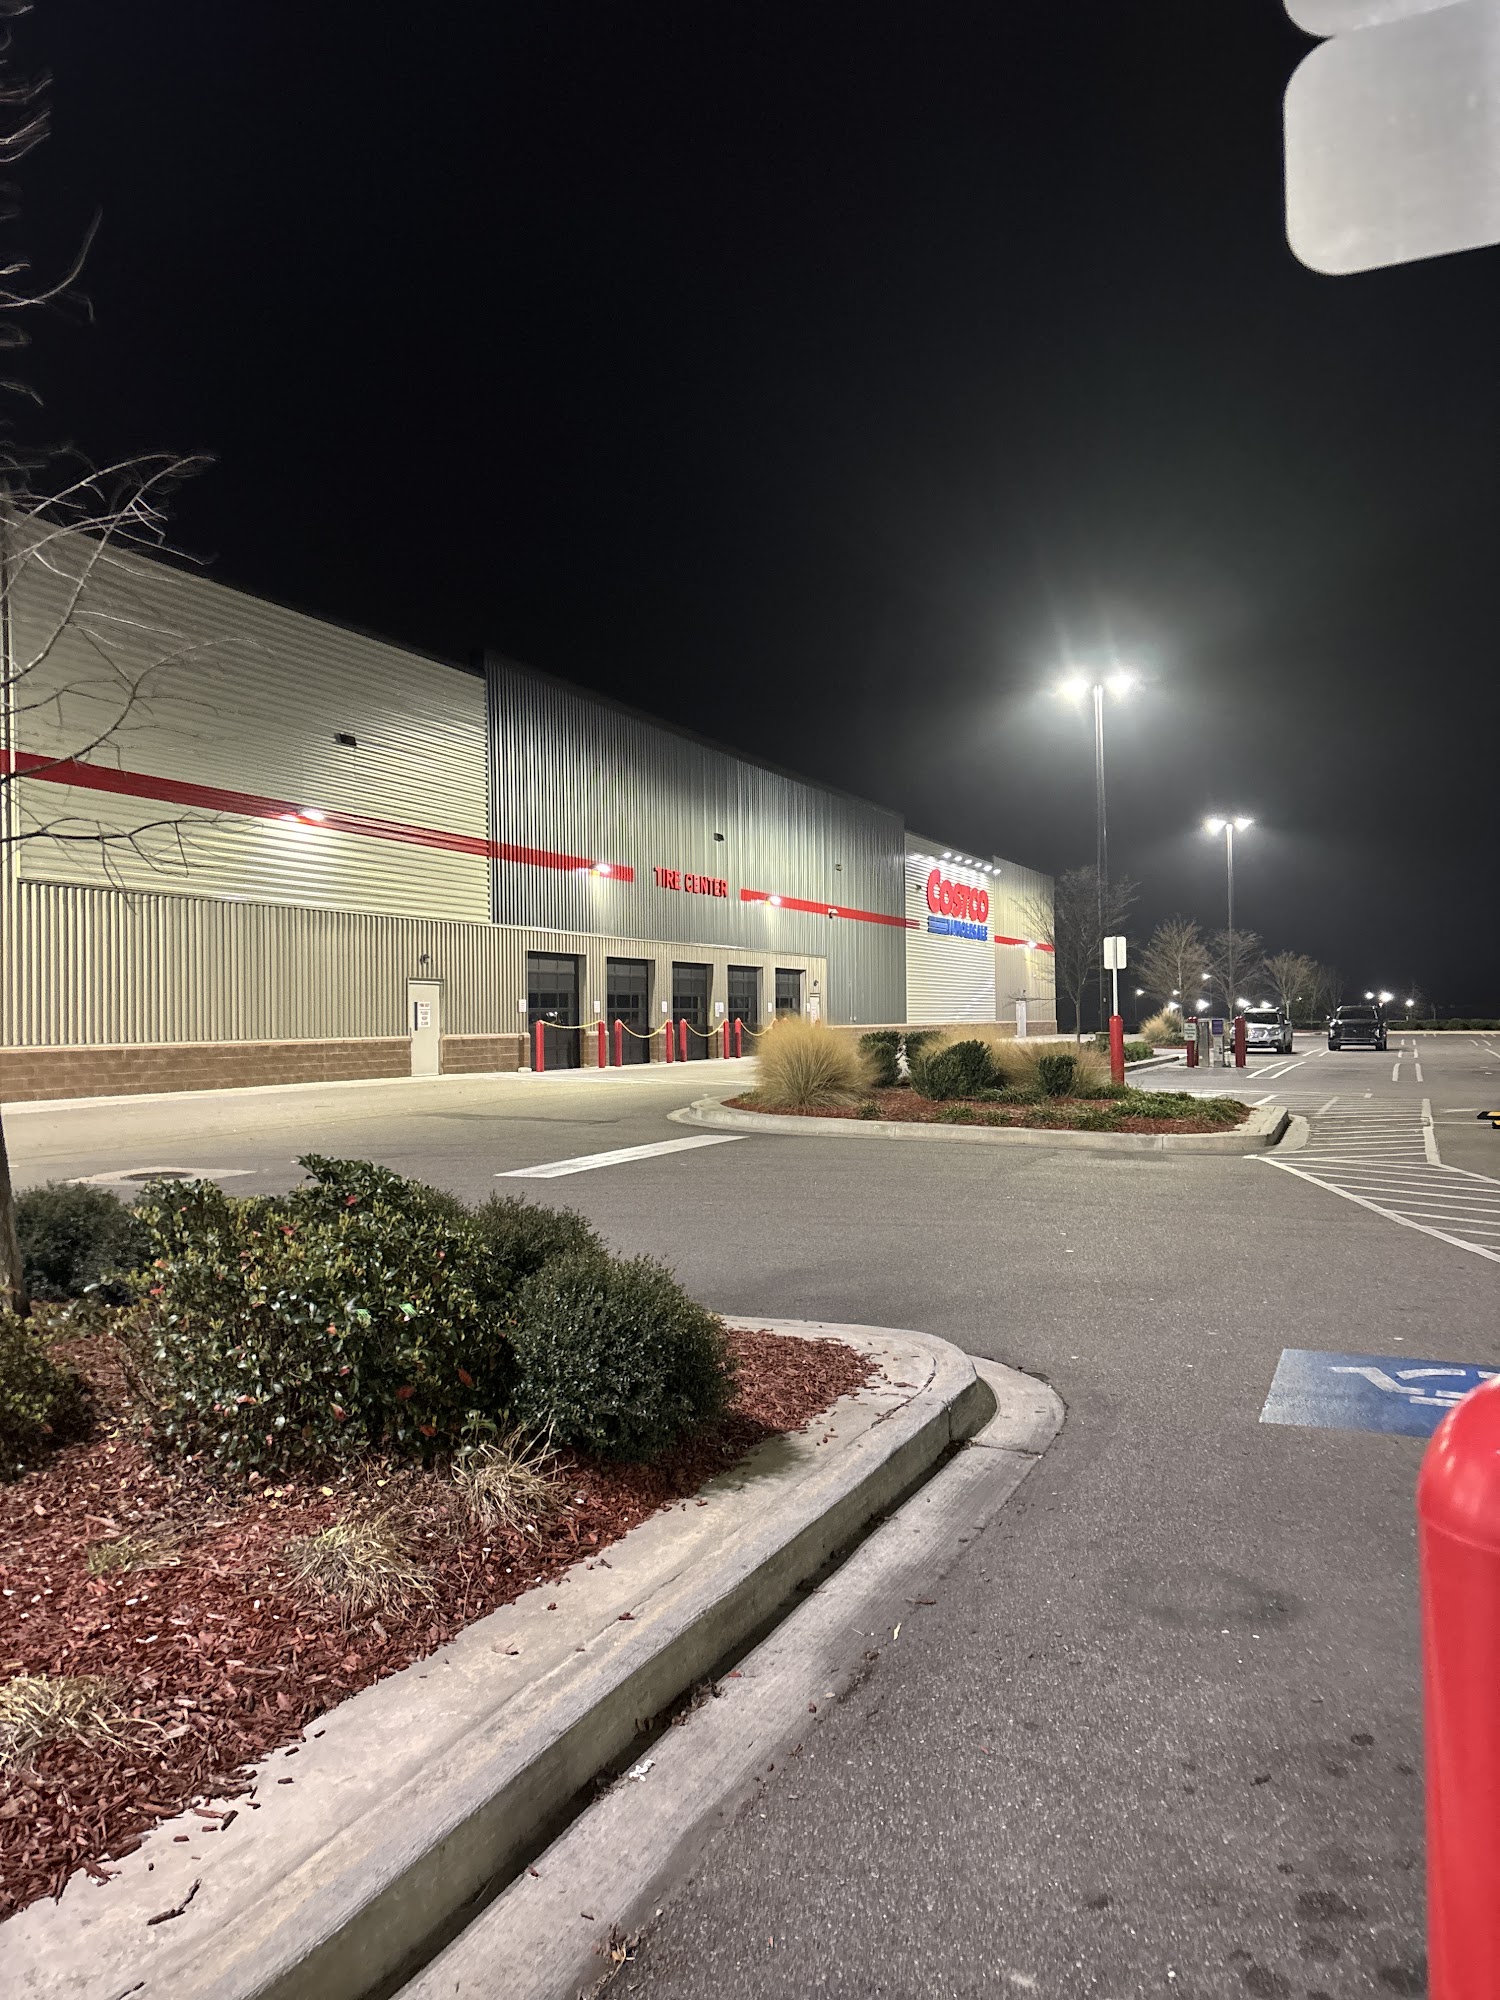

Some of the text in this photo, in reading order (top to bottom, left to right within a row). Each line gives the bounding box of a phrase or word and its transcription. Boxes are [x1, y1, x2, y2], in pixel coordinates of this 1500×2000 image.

[653, 867, 728, 898] TIRE CENTER
[927, 869, 989, 923] COSTCO
